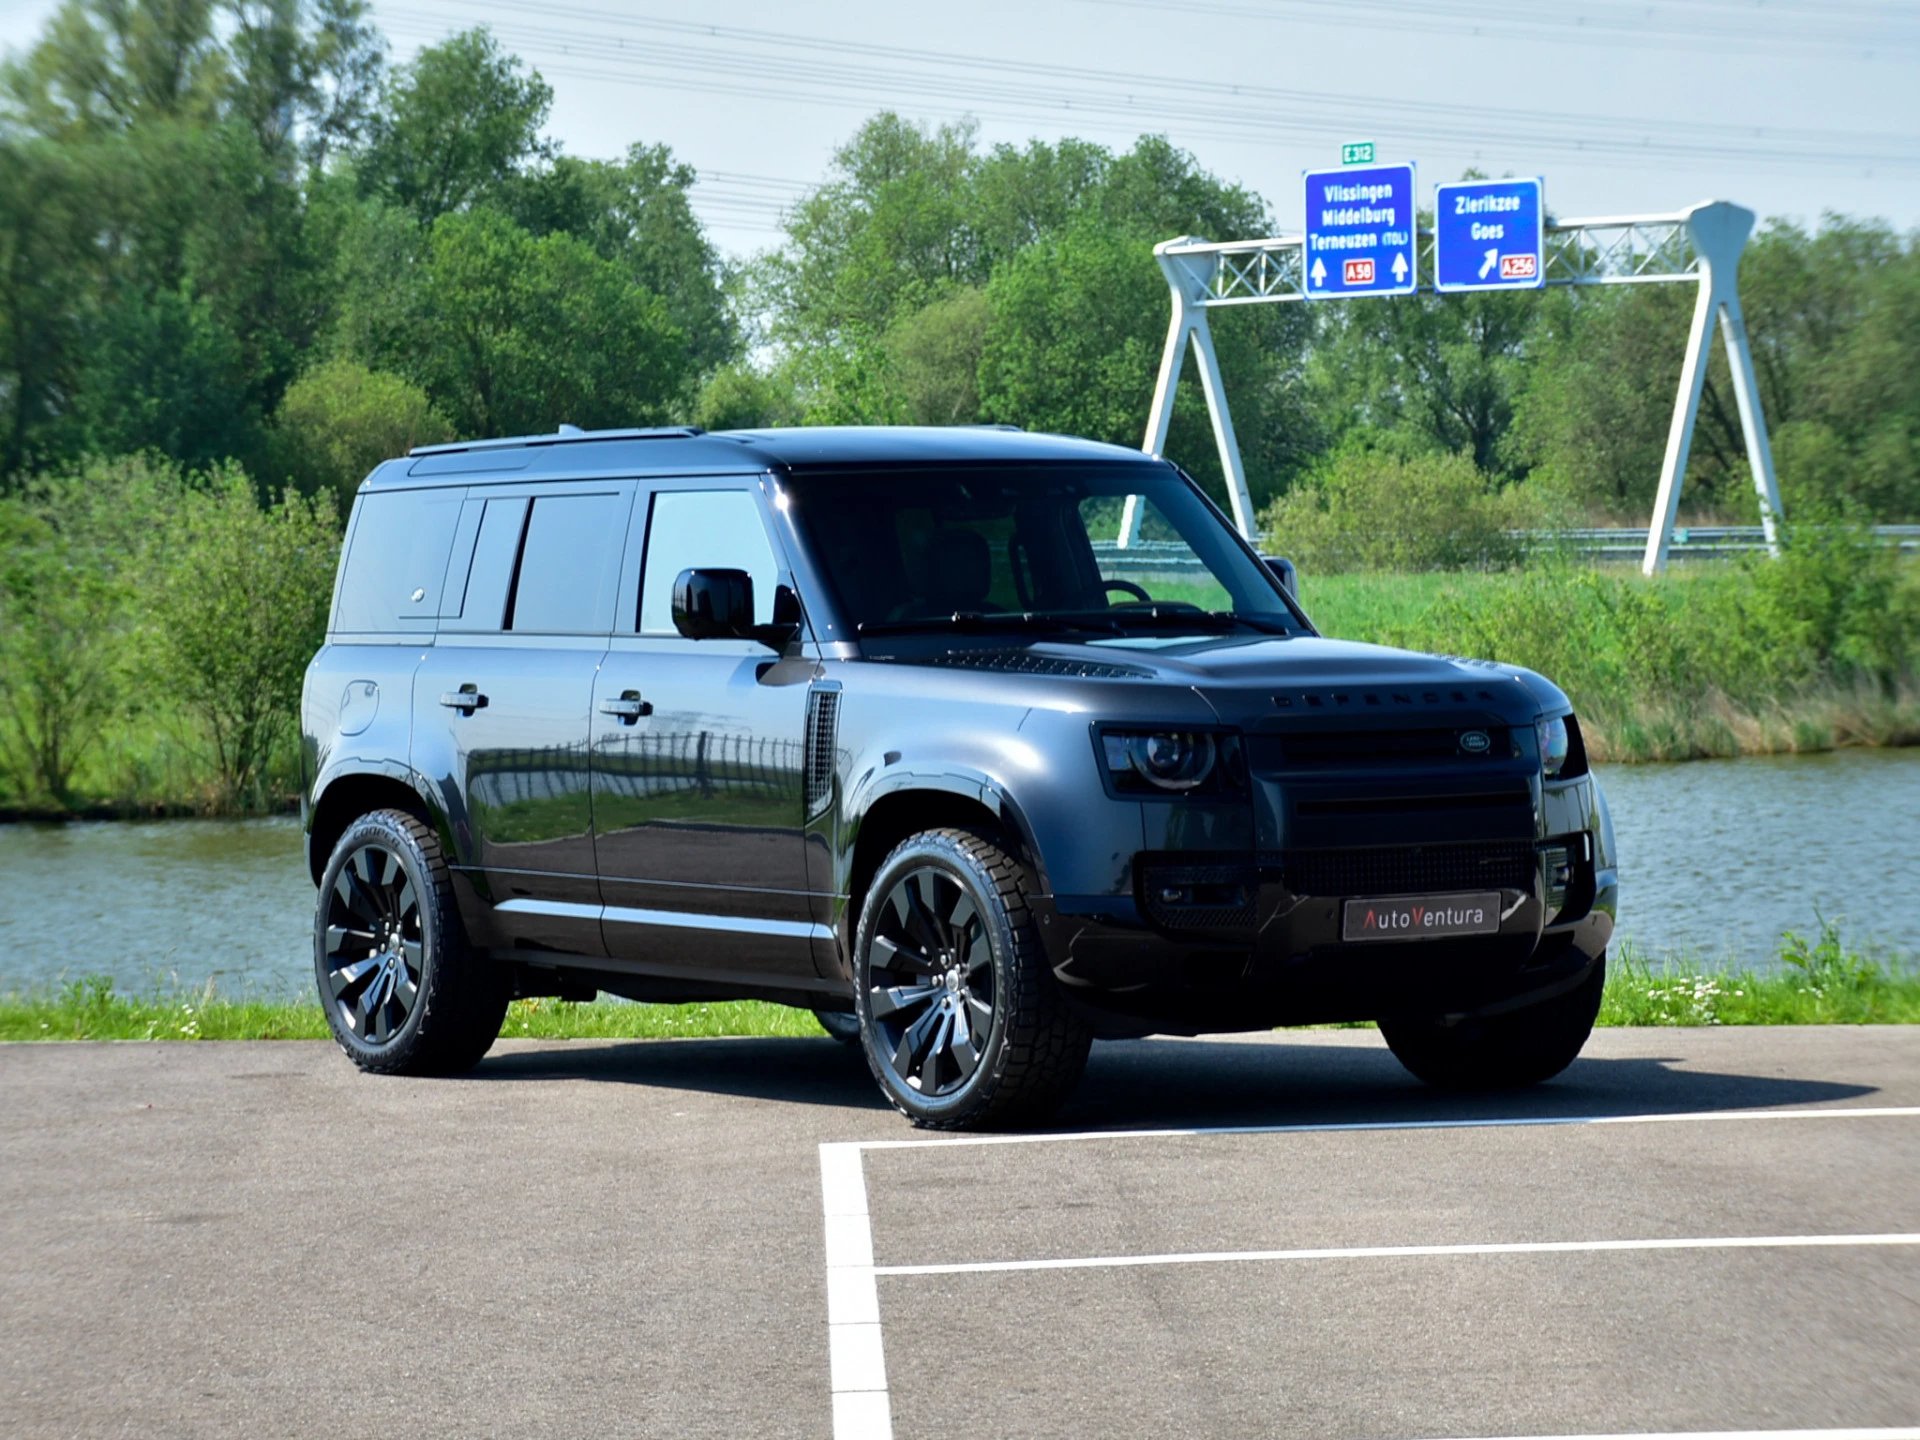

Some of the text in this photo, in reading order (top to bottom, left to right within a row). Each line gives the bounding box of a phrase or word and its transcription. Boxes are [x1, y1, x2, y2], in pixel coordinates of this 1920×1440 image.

[1324, 183, 1393, 205] Vlissingen
[1455, 195, 1520, 215] Zierikzee
[1322, 207, 1395, 227] Middelburg
[1310, 231, 1408, 251] Terneuzen (TOL)
[1471, 222, 1504, 241] Goes
[1271, 691, 1494, 708] DEFENDER
[1364, 907, 1483, 930] AutoVentura
